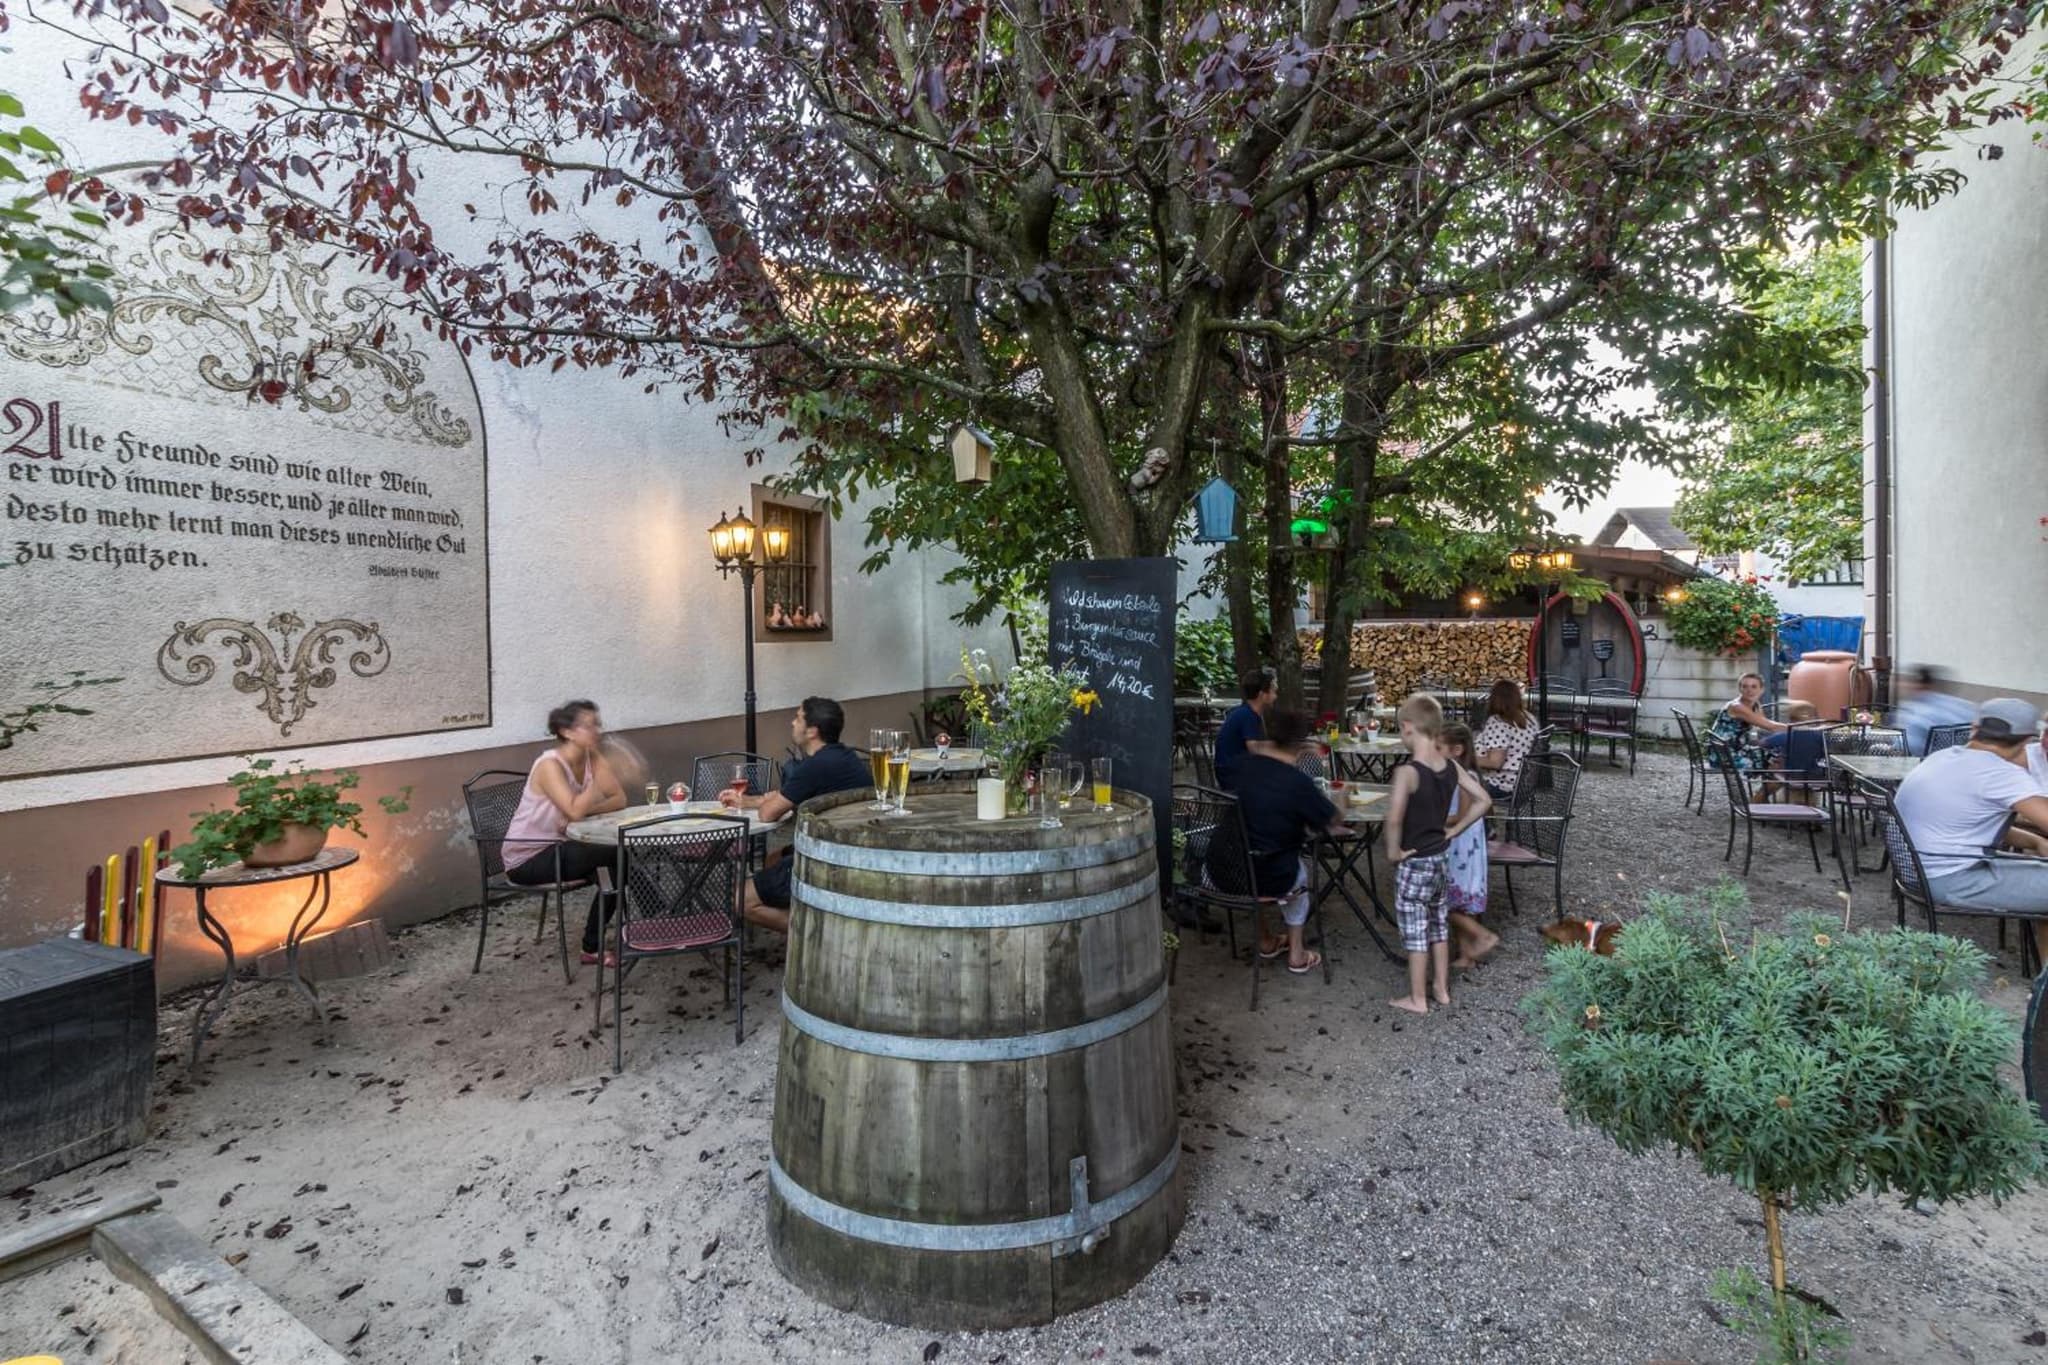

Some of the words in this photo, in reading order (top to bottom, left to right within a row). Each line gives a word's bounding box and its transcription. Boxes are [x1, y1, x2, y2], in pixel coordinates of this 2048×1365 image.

[9, 462, 42, 482] er
[50, 463, 117, 490] wird
[125, 470, 204, 499] immer
[211, 481, 284, 511] besser,
[287, 492, 322, 512] und
[327, 494, 345, 520] je
[349, 496, 387, 519] älter
[392, 506, 425, 523] man
[427, 508, 464, 529] wird,
[115, 430, 221, 468] Freunde
[229, 451, 279, 475] sind
[286, 460, 321, 482] wie
[326, 467, 372, 488] alter
[381, 470, 432, 498] Wein,
[7, 493, 88, 524] desto
[97, 507, 161, 533] mehr
[169, 510, 224, 535] lernt
[231, 520, 274, 538] man
[280, 519, 340, 544] dieses
[346, 529, 431, 555] unendliche
[435, 534, 466, 554] Gut
[15, 541, 54, 565] zu
[67, 539, 208, 571] schätzen.
